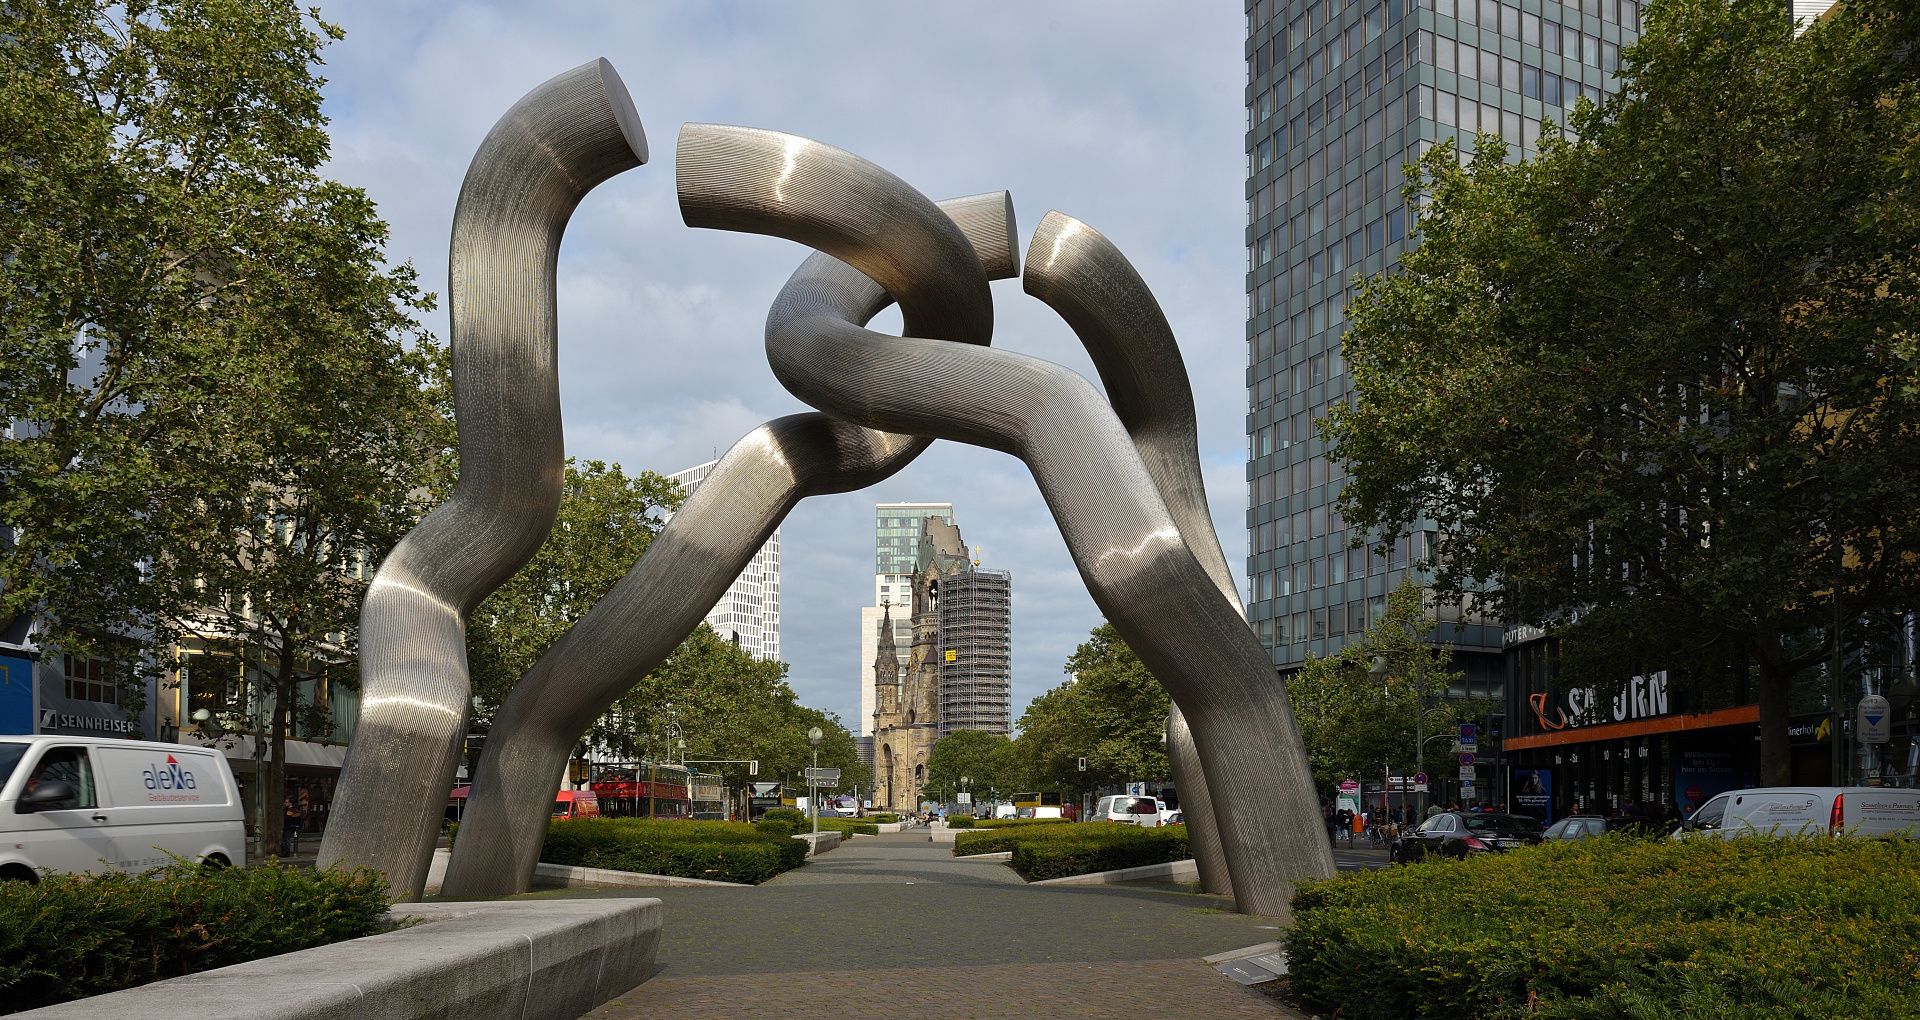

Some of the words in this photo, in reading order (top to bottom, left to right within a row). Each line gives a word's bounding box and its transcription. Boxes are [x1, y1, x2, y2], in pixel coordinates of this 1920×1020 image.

[60, 714, 134, 733] SENNHEISER
[1623, 748, 1630, 759] 21
[1638, 746, 1649, 758] Uhr
